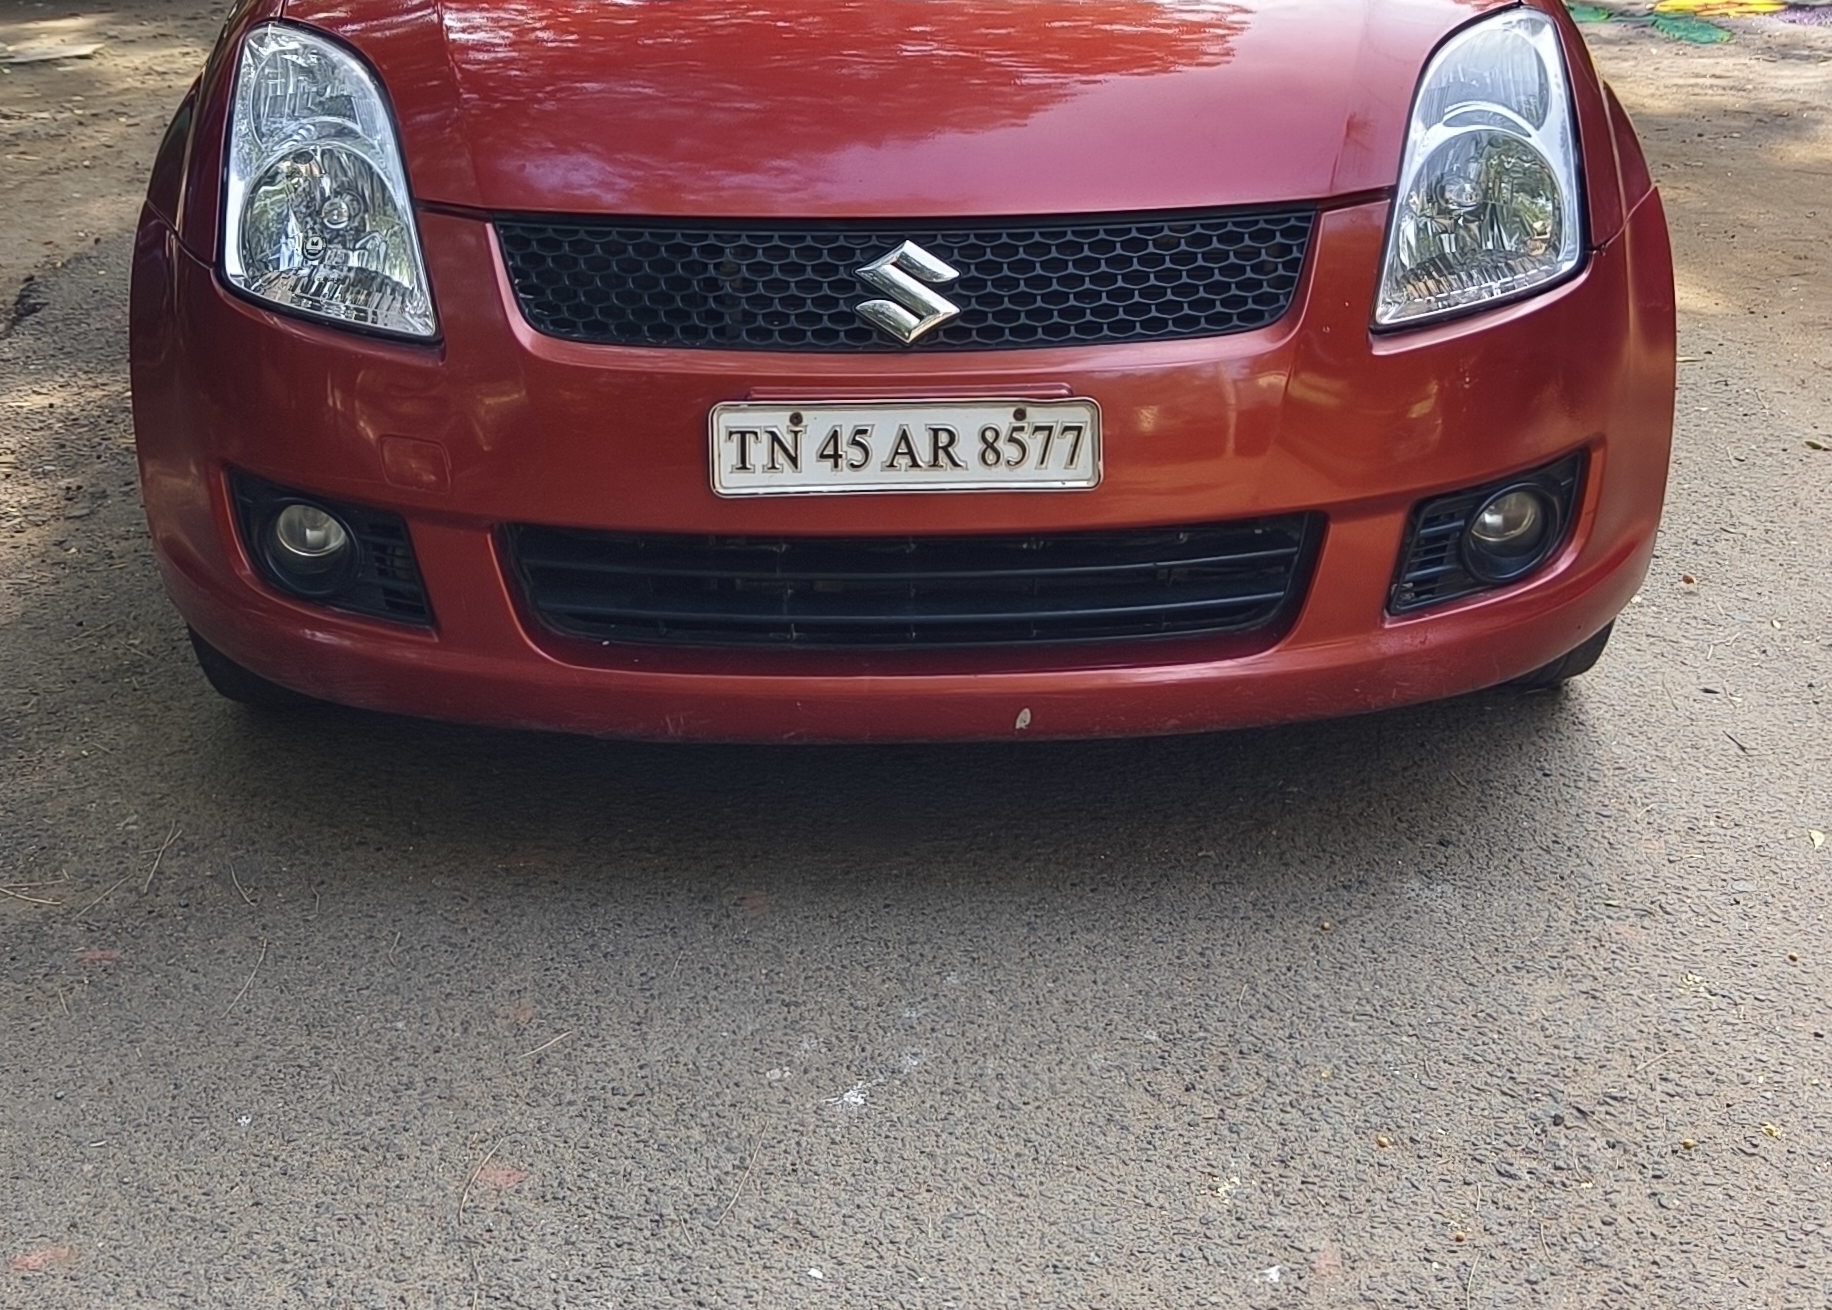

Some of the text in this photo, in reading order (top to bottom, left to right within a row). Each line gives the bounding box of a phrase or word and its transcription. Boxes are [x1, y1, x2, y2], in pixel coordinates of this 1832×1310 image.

[726, 420, 1087, 474] TN 45 AR 8577
